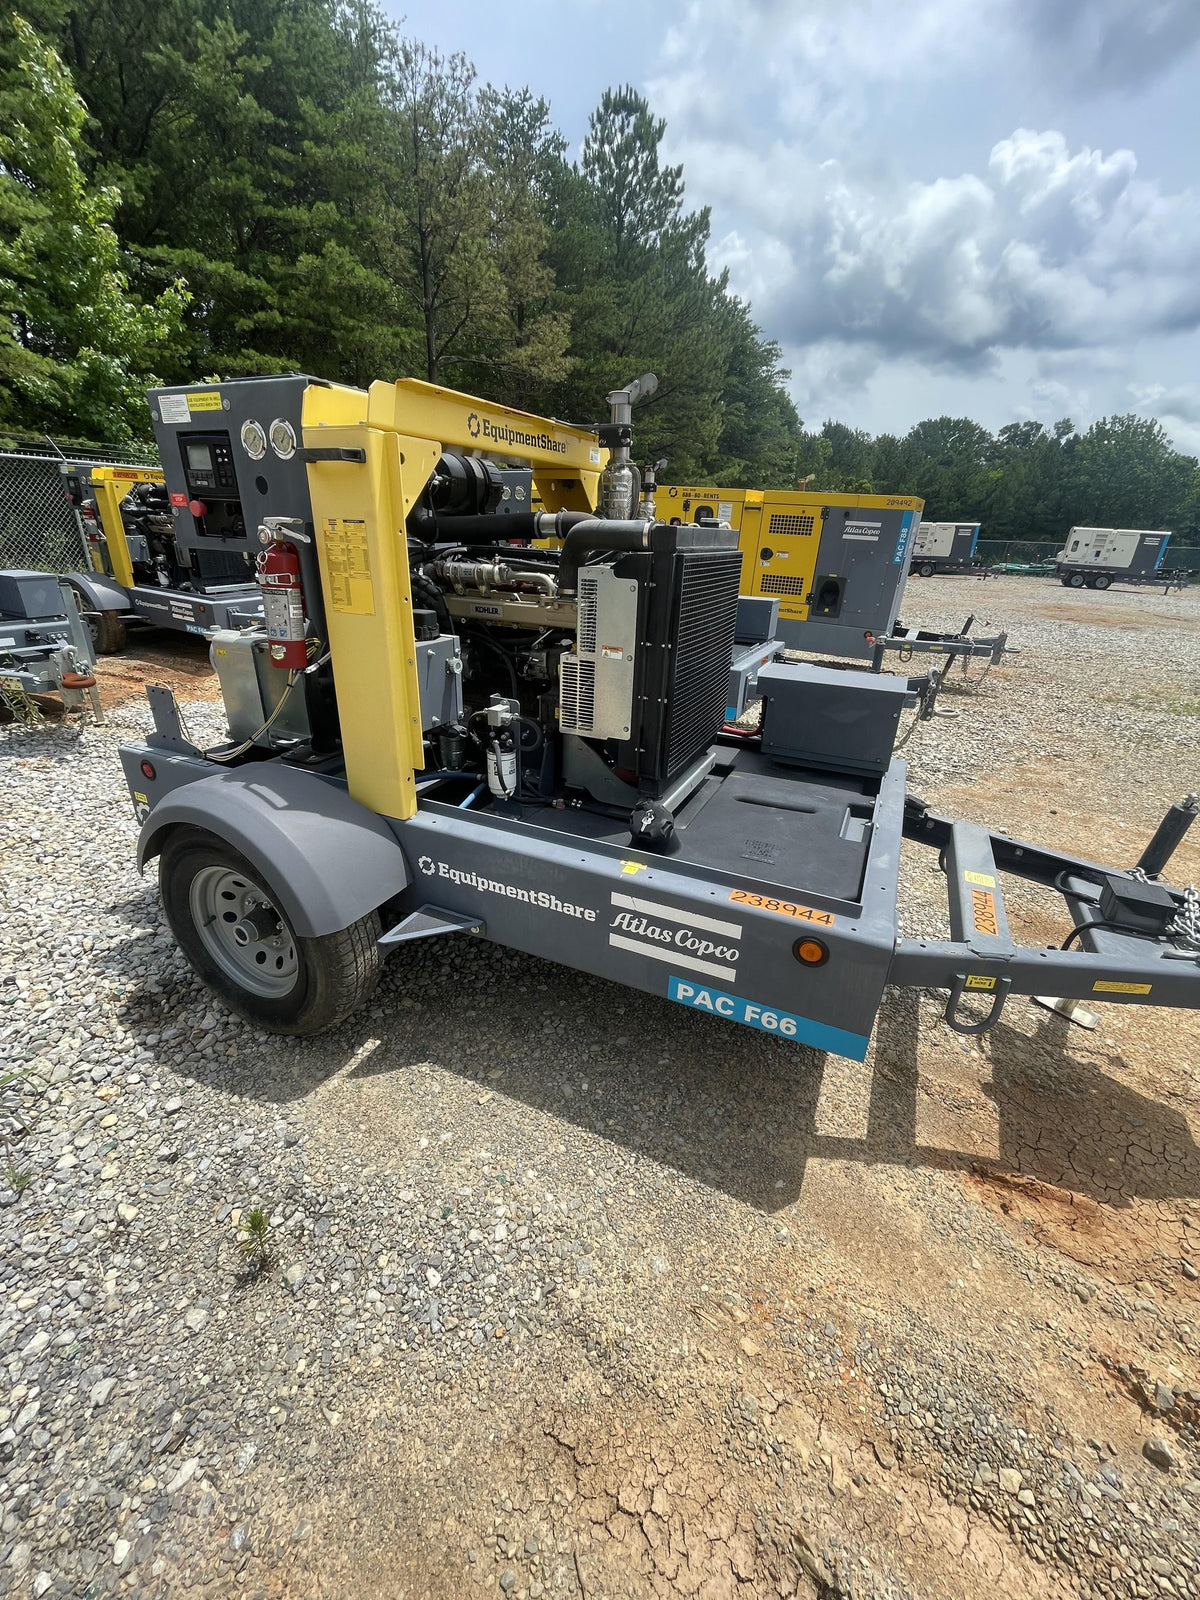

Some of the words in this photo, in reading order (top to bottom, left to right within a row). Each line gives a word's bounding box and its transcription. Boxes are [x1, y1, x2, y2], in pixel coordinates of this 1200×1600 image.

[482, 418, 566, 454] EquipmentShare
[886, 498, 913, 506] 209492
[844, 526, 861, 534] Atlas
[862, 527, 880, 535] Copco
[899, 528, 908, 543] F88
[895, 545, 904, 562] PAC
[475, 606, 499, 615] KOHLER
[438, 862, 596, 922] EquipmentShare
[730, 891, 833, 926] 238944
[972, 889, 997, 935] 238944
[610, 912, 672, 942] Atlas
[674, 929, 739, 961] Copco
[676, 983, 734, 1016] PAC
[744, 1005, 797, 1035] F66
